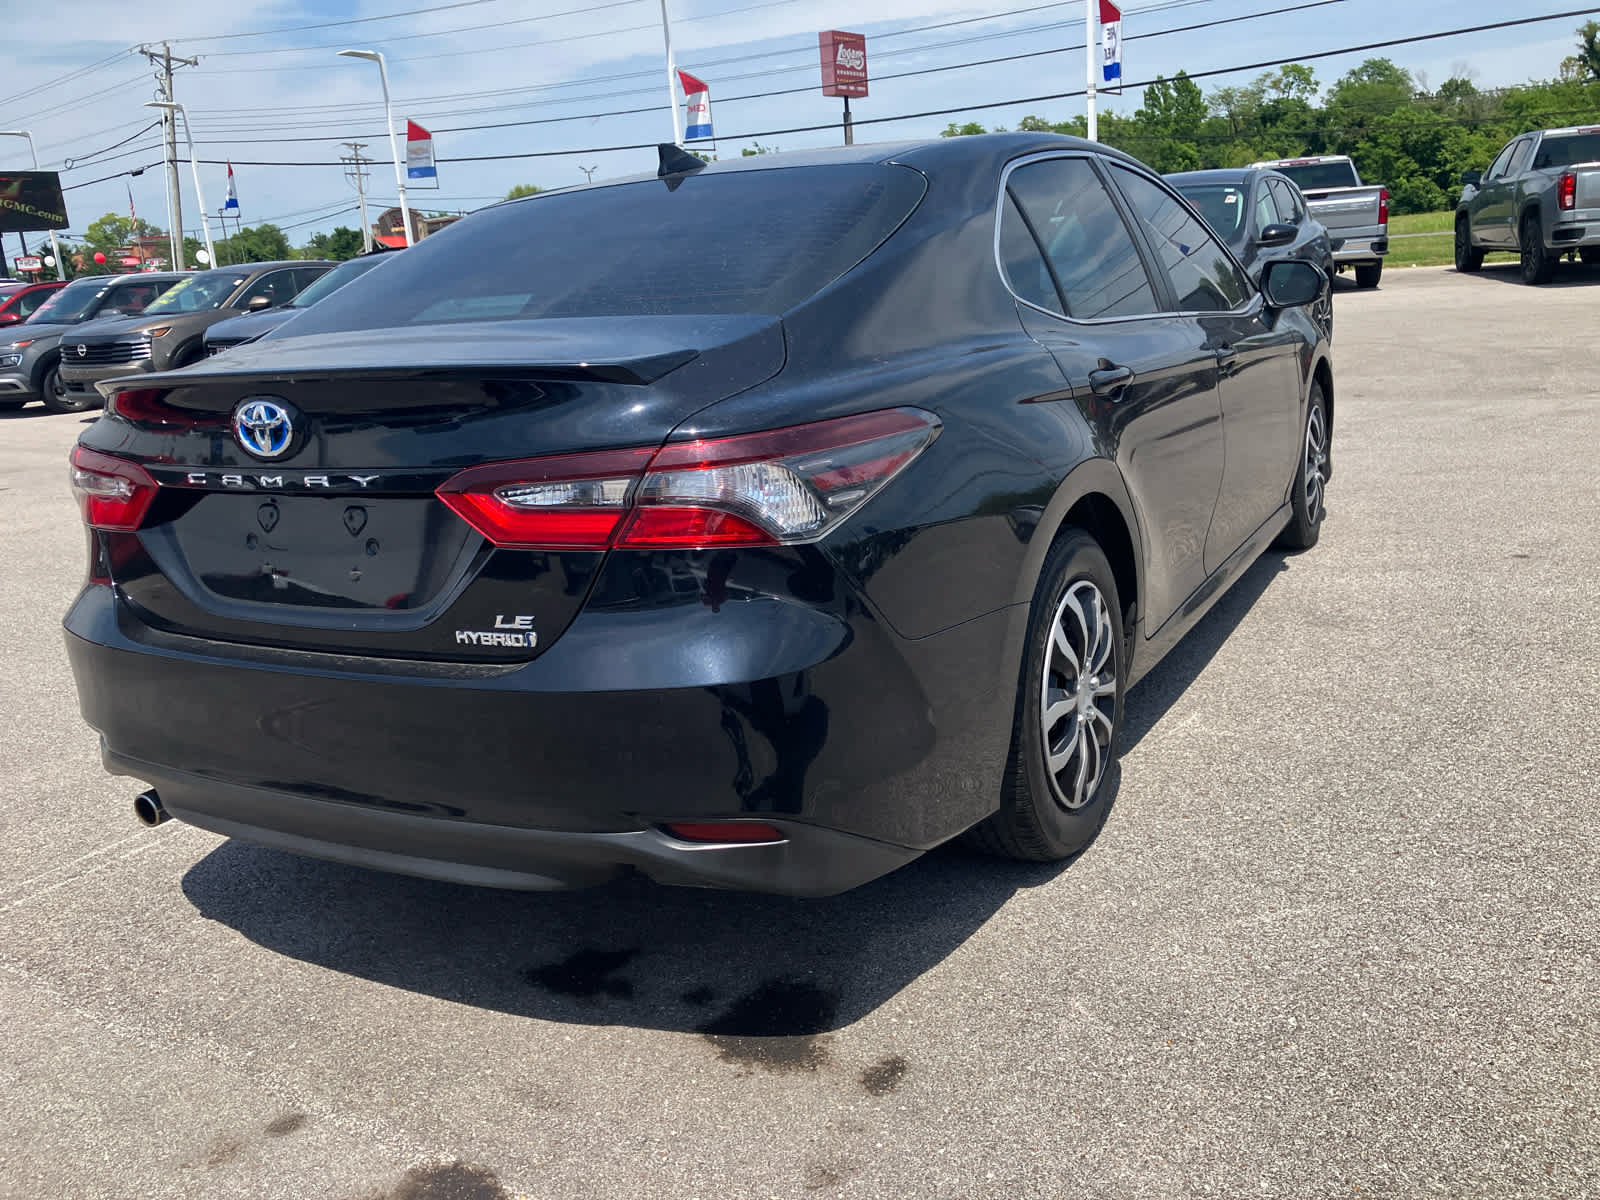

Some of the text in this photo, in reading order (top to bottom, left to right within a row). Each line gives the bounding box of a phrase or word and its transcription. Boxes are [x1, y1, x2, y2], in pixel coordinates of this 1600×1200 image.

[0, 199, 63, 222] GMC.com
[187, 472, 380, 488] CAMRY
[494, 614, 535, 629] LE
[455, 630, 523, 647] HYBRID
